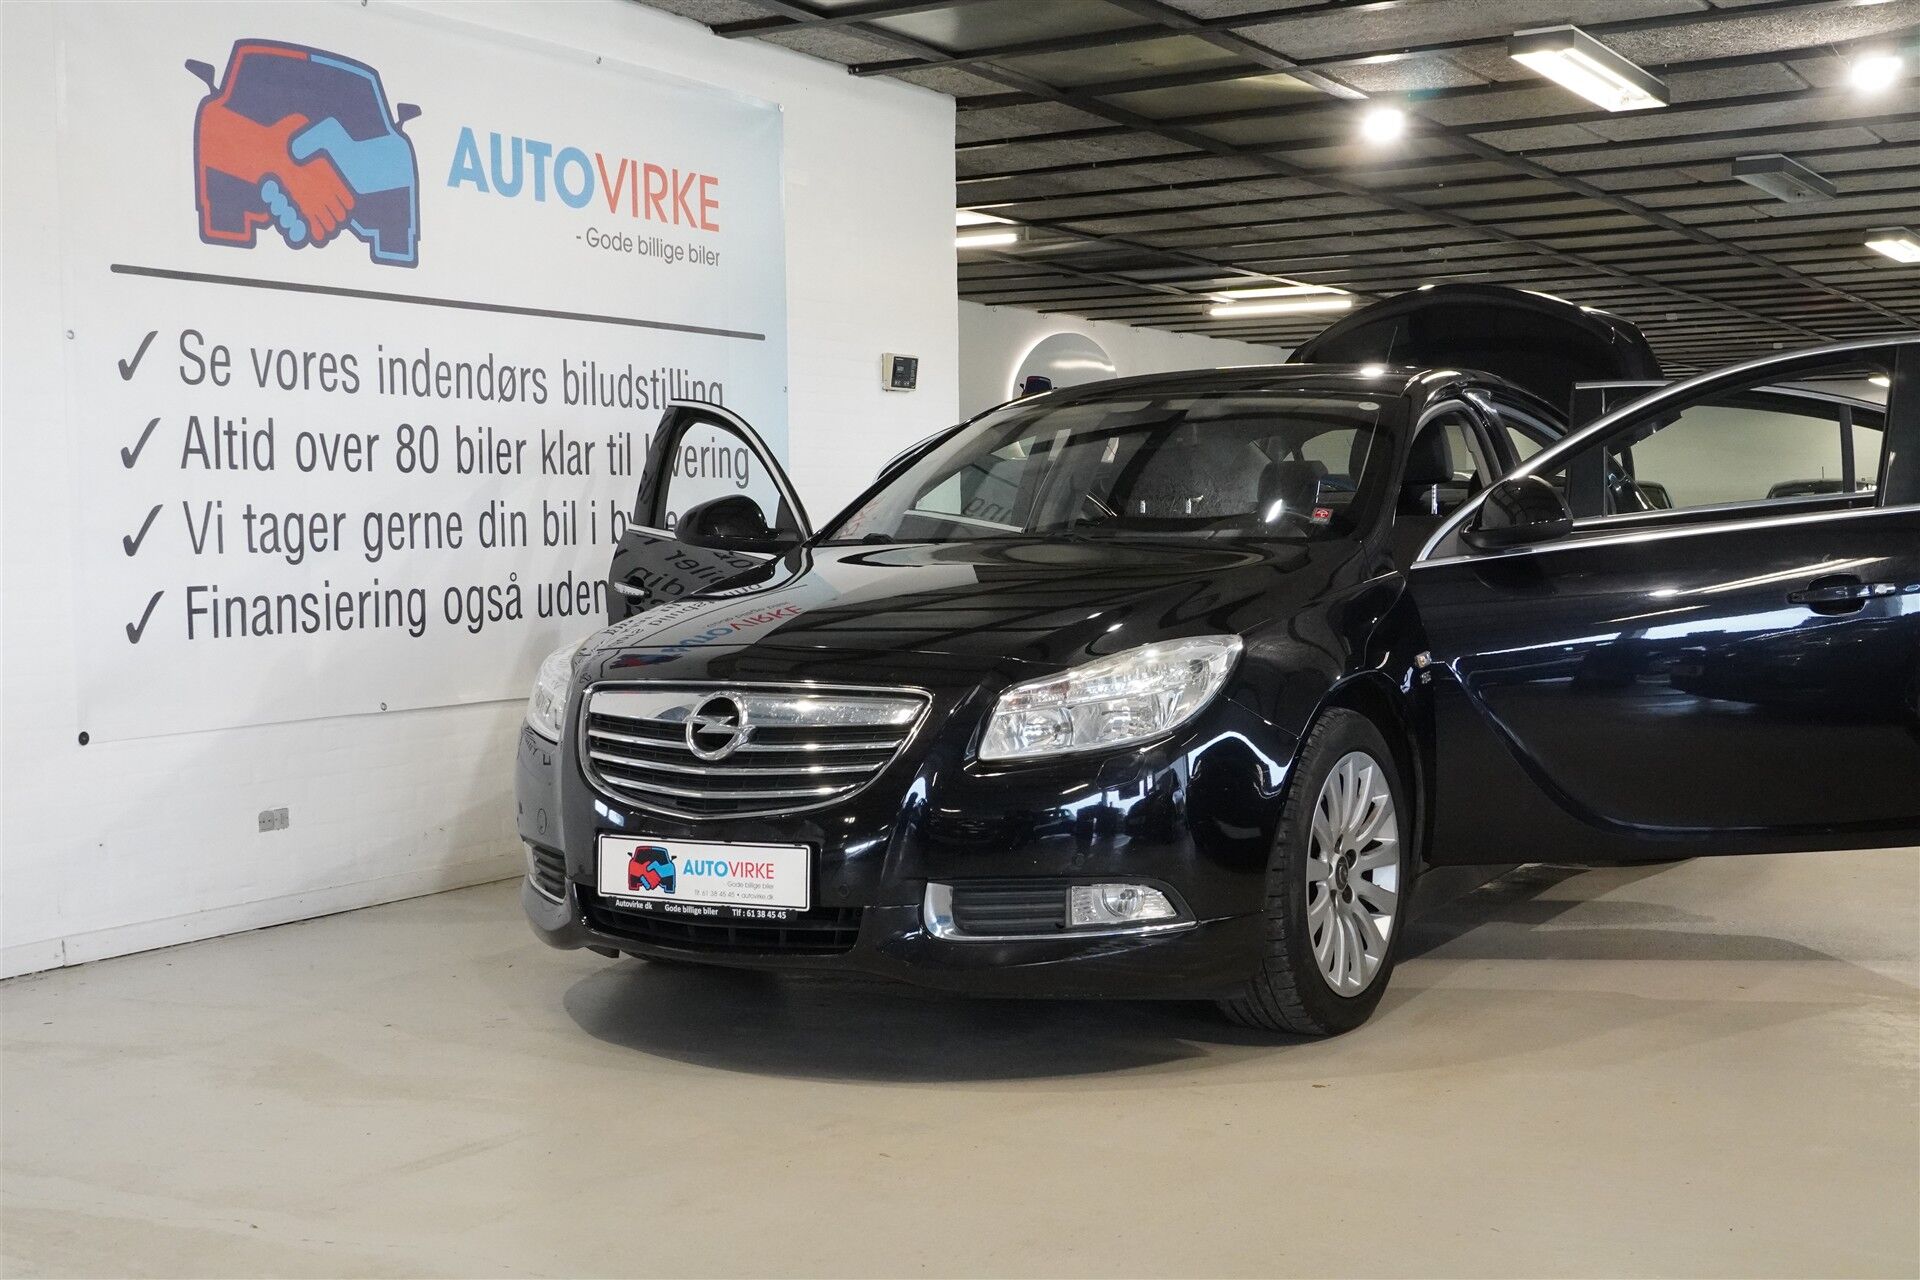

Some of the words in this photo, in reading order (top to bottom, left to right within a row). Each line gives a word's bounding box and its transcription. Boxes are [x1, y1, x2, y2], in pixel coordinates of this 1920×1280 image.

[447, 127, 720, 233] AUTOVIRKE
[586, 227, 632, 252] Gode
[638, 235, 684, 264] billige
[689, 244, 720, 266] biler
[180, 329, 231, 387] Se
[250, 348, 361, 396] vores
[378, 344, 547, 405] indendørs
[181, 416, 274, 471] Altid
[296, 432, 380, 474] over
[396, 423, 439, 475] 80
[456, 425, 527, 476] biler
[541, 429, 596, 477] klar
[607, 432, 631, 477] til
[645, 433, 750, 489] lvering
[183, 500, 223, 555] Vi
[242, 503, 347, 567] tager
[363, 511, 462, 564] gerne
[479, 500, 528, 549] din
[543, 500, 577, 547] bil
[591, 500, 597, 546] i
[186, 578, 426, 641] Finansiering
[444, 571, 523, 635] også
[538, 570, 608, 618] uden
[683, 859, 774, 880] AUTOVIRKE
[615, 899, 643, 909] Autovirke
[664, 904, 681, 912] Gode
[682, 905, 702, 916] billige
[703, 907, 718, 916] biler
[746, 909, 755, 918] 61
[756, 910, 766, 918] 38
[766, 910, 776, 919] 45
[777, 911, 787, 919] 45
